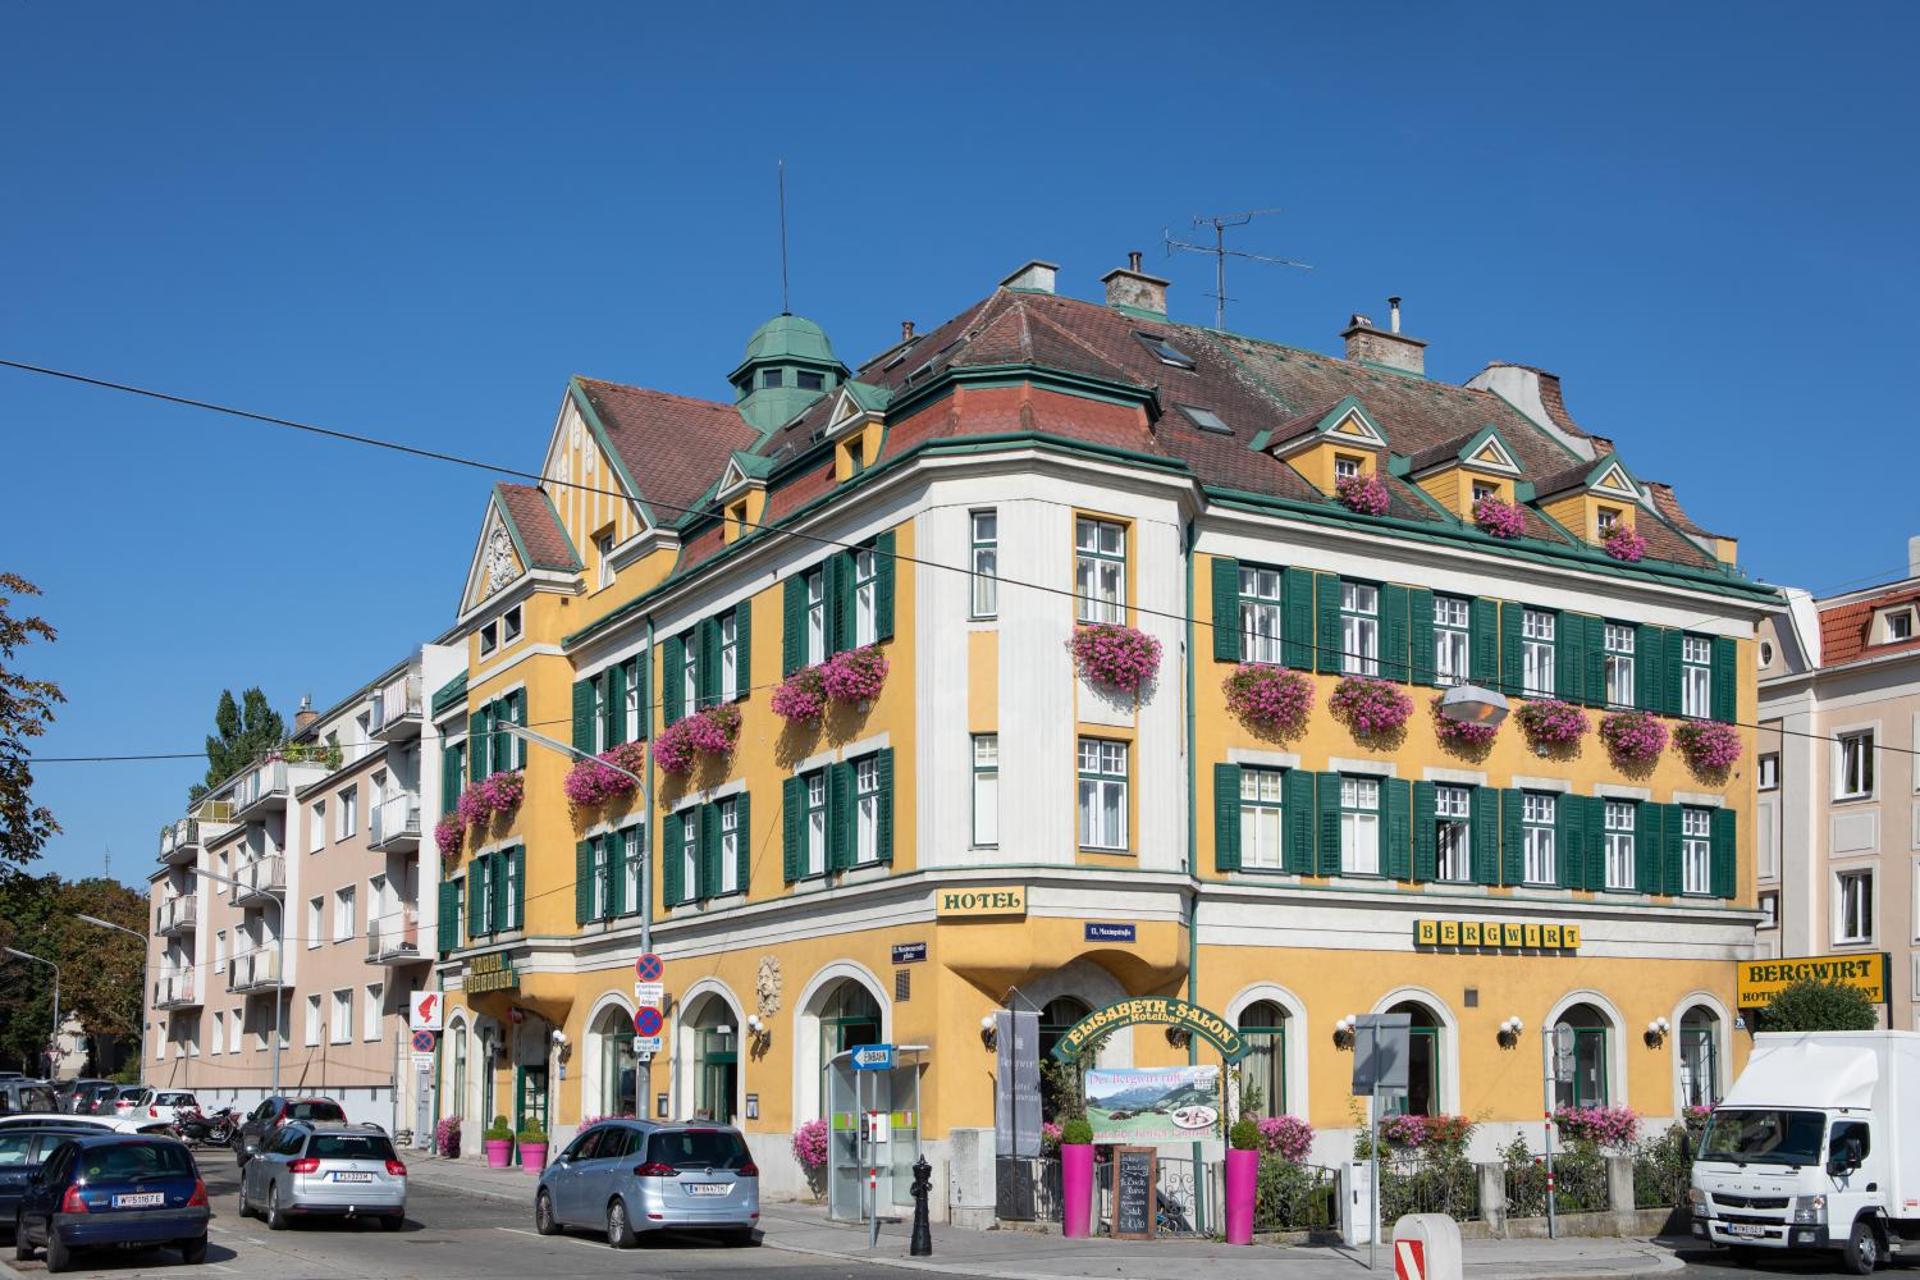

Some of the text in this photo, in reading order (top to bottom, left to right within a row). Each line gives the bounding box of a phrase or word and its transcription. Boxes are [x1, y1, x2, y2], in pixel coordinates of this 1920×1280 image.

[944, 892, 1021, 910] HOTEL
[1422, 925, 1577, 943] BERGWIRT
[1749, 960, 1871, 983] BERGWIRT
[1068, 999, 1235, 1046] ELISABETH-SALON
[1130, 1011, 1181, 1024] Hotelbar
